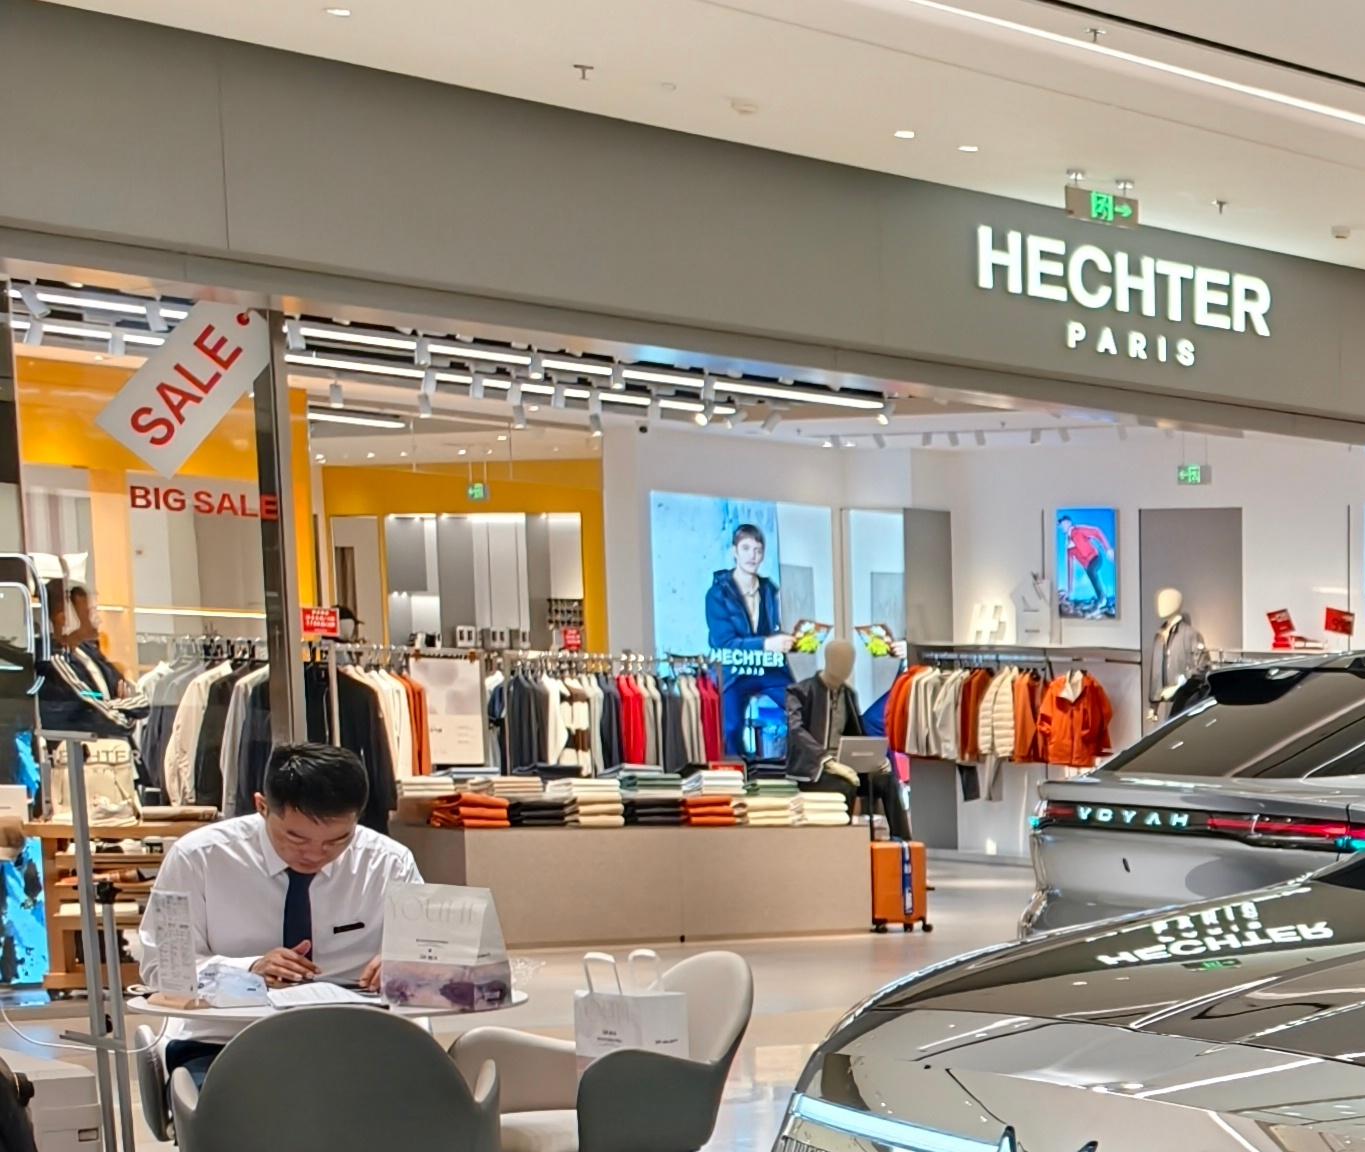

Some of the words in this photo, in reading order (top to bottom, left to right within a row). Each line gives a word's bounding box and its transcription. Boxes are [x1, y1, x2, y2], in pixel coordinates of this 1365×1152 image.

[977, 225, 1272, 338] HECHTER
[1067, 320, 1197, 367] PARIS
[130, 323, 244, 447] SALE
[130, 484, 186, 512] BIG
[193, 489, 279, 522] SALE
[710, 648, 784, 667] HECHTER
[1077, 805, 1190, 828] VOYAH
